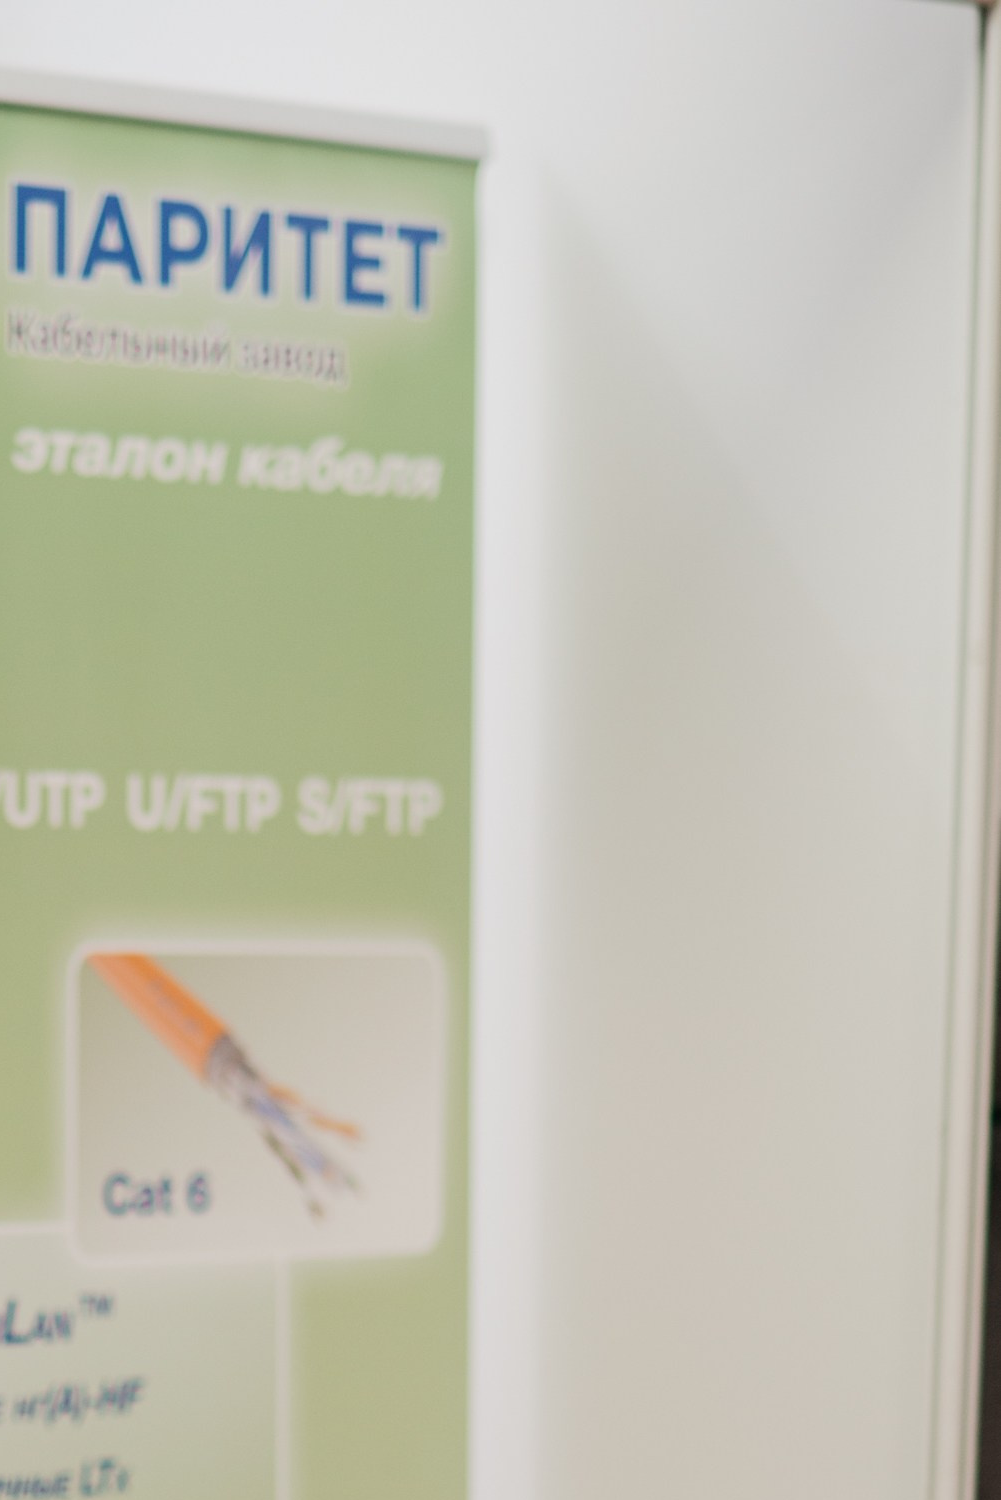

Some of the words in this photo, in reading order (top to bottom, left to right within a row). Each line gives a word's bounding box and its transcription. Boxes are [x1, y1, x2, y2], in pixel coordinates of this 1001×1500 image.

[15, 183, 441, 310] ПАРИТЕТ
[8, 312, 229, 371] Кабельный
[242, 340, 346, 386] завод
[10, 428, 228, 486] эталон
[237, 436, 443, 499] кабеля
[125, 772, 280, 832] U/FTP
[298, 775, 443, 836] S/FTP
[102, 1172, 173, 1217] Cat
[186, 1171, 212, 1214] 6
